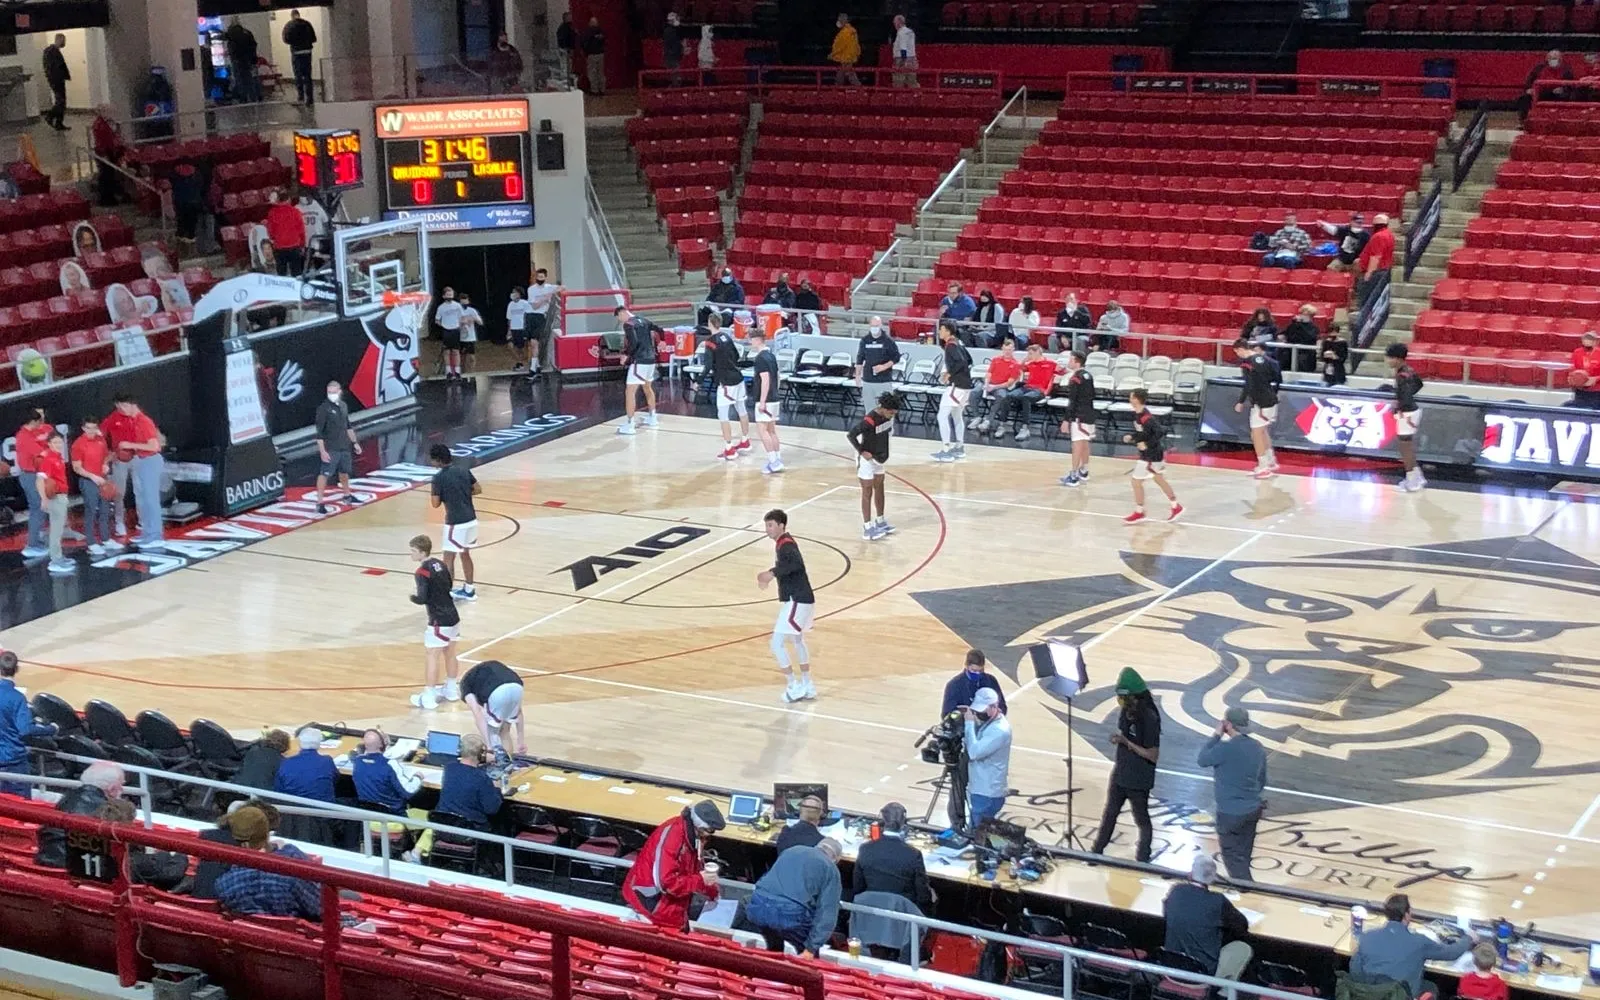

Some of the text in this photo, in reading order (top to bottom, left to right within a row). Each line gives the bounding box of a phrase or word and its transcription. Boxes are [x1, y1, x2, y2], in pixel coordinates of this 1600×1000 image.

[380, 112, 404, 132] W
[405, 108, 524, 123] WADE ASSOCIATES
[424, 137, 486, 163] 31:46
[392, 165, 441, 180] DAVIDSON
[472, 162, 516, 176] LASALLE
[413, 179, 428, 202] 0
[455, 180, 466, 198] 1
[504, 175, 519, 197] 0
[449, 413, 577, 457] BARINGS
[225, 471, 284, 505] BARINGS
[81, 853, 101, 877] 11
